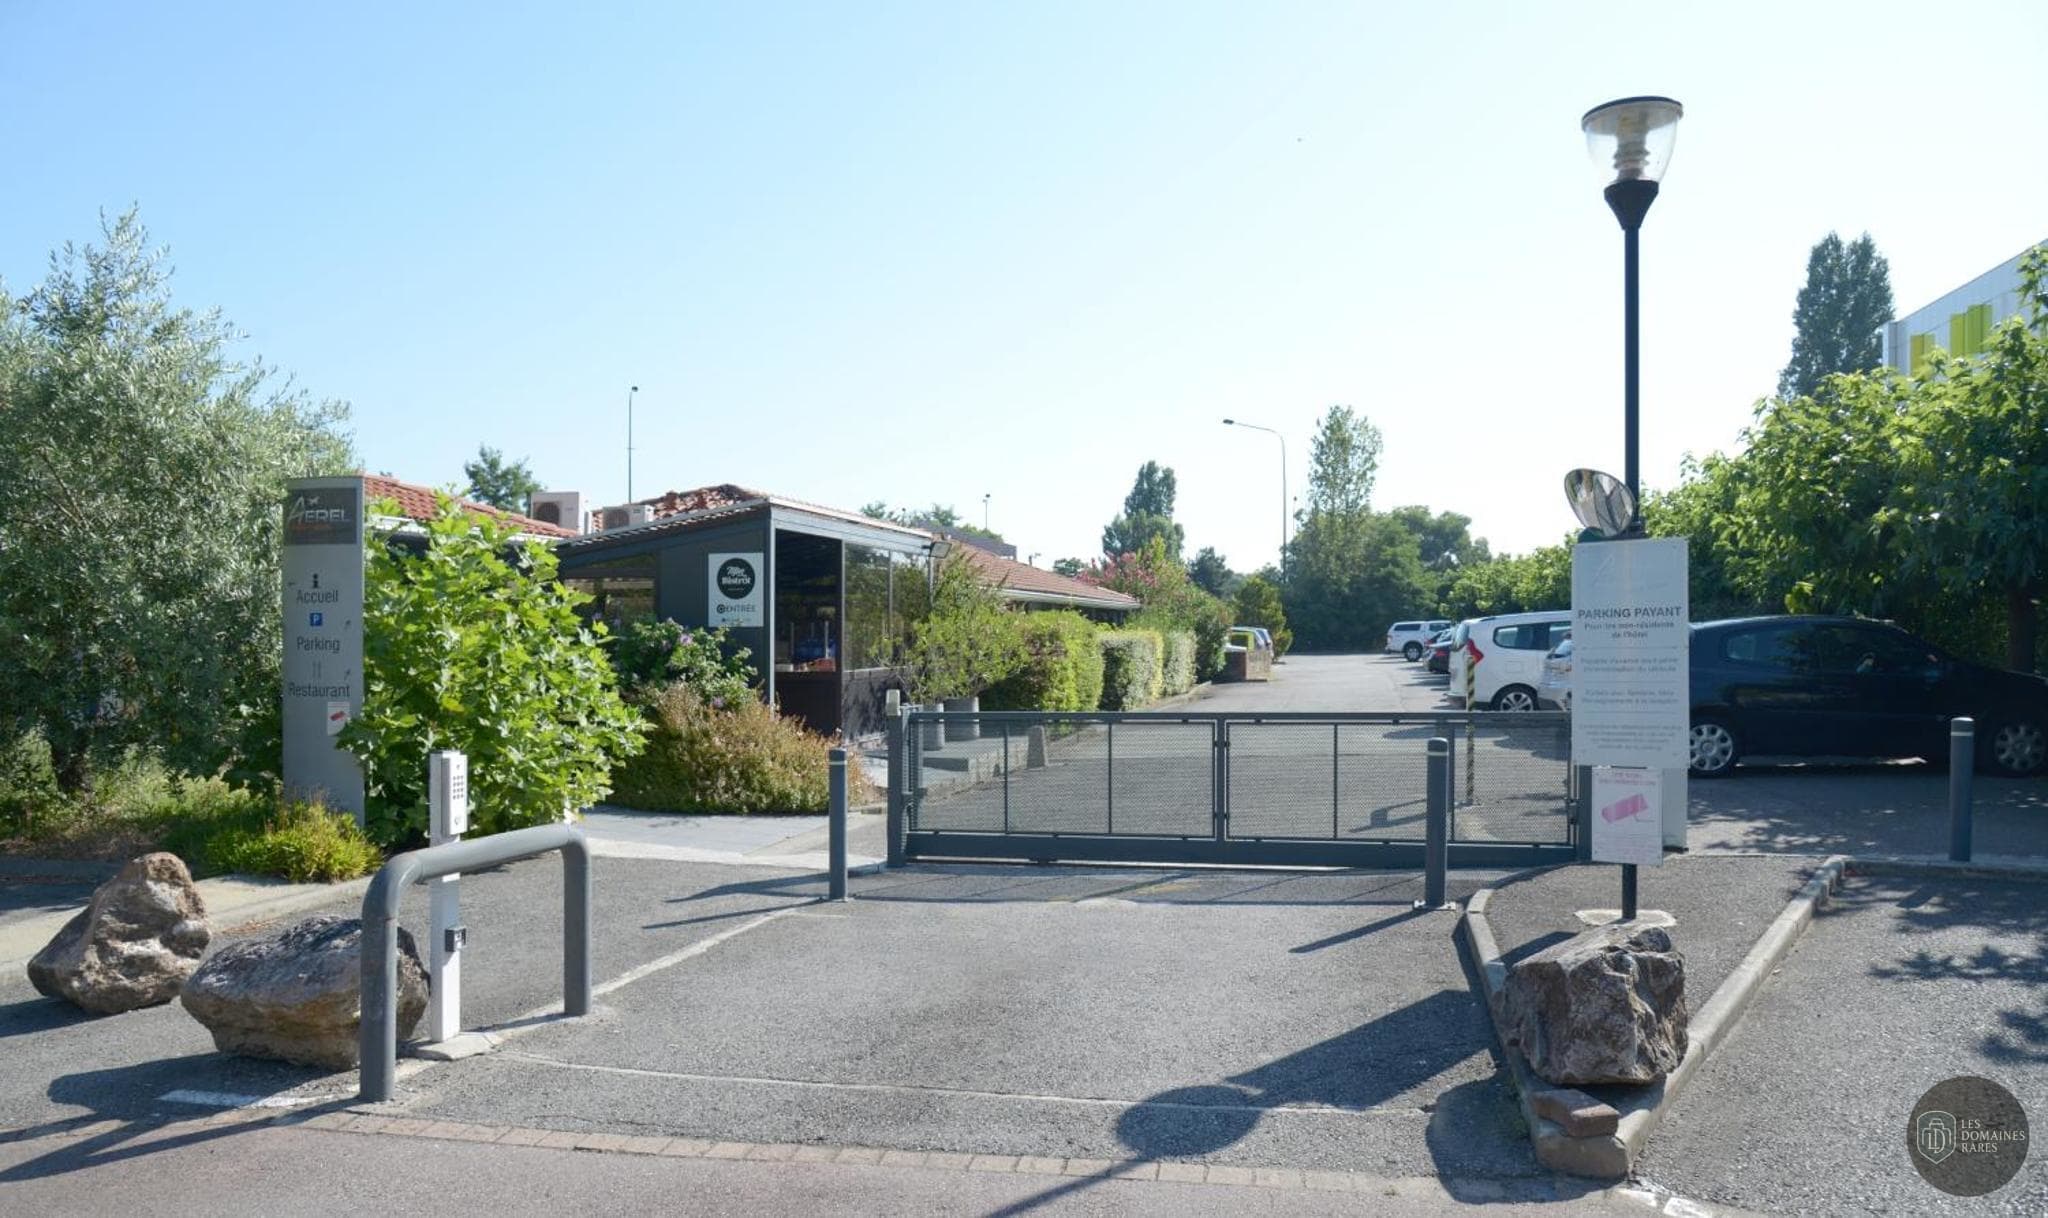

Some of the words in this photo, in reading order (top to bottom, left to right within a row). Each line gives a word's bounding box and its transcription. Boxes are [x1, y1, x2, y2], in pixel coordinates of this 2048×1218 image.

[296, 590, 339, 603] Accueil
[1578, 608, 1631, 619] PARKING
[1634, 606, 1682, 618] PAYANT
[296, 636, 340, 653] Parking
[288, 682, 350, 697] Restaurant
